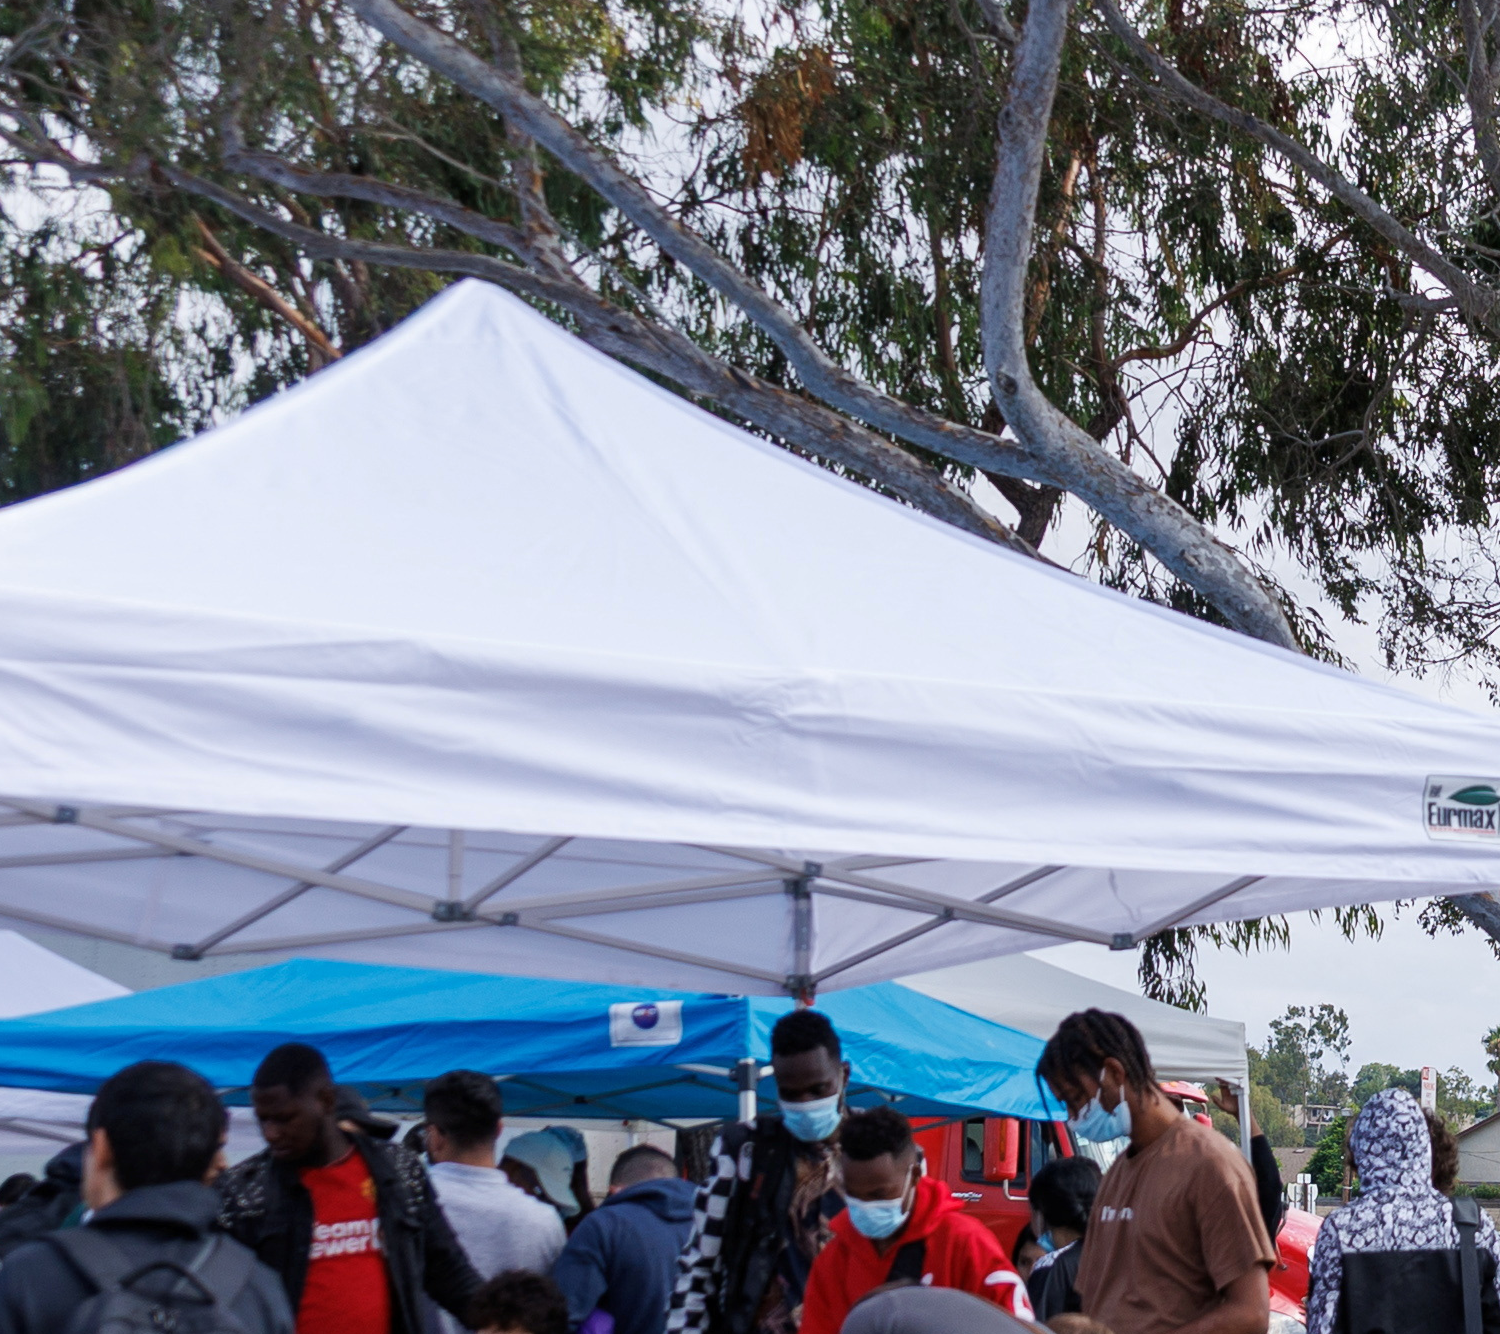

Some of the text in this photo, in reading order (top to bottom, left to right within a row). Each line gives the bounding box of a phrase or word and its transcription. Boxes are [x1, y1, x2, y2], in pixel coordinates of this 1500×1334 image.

[1428, 801, 1496, 829] Eurmax
[313, 1218, 369, 1241] eam
[308, 1235, 370, 1259] ewer
